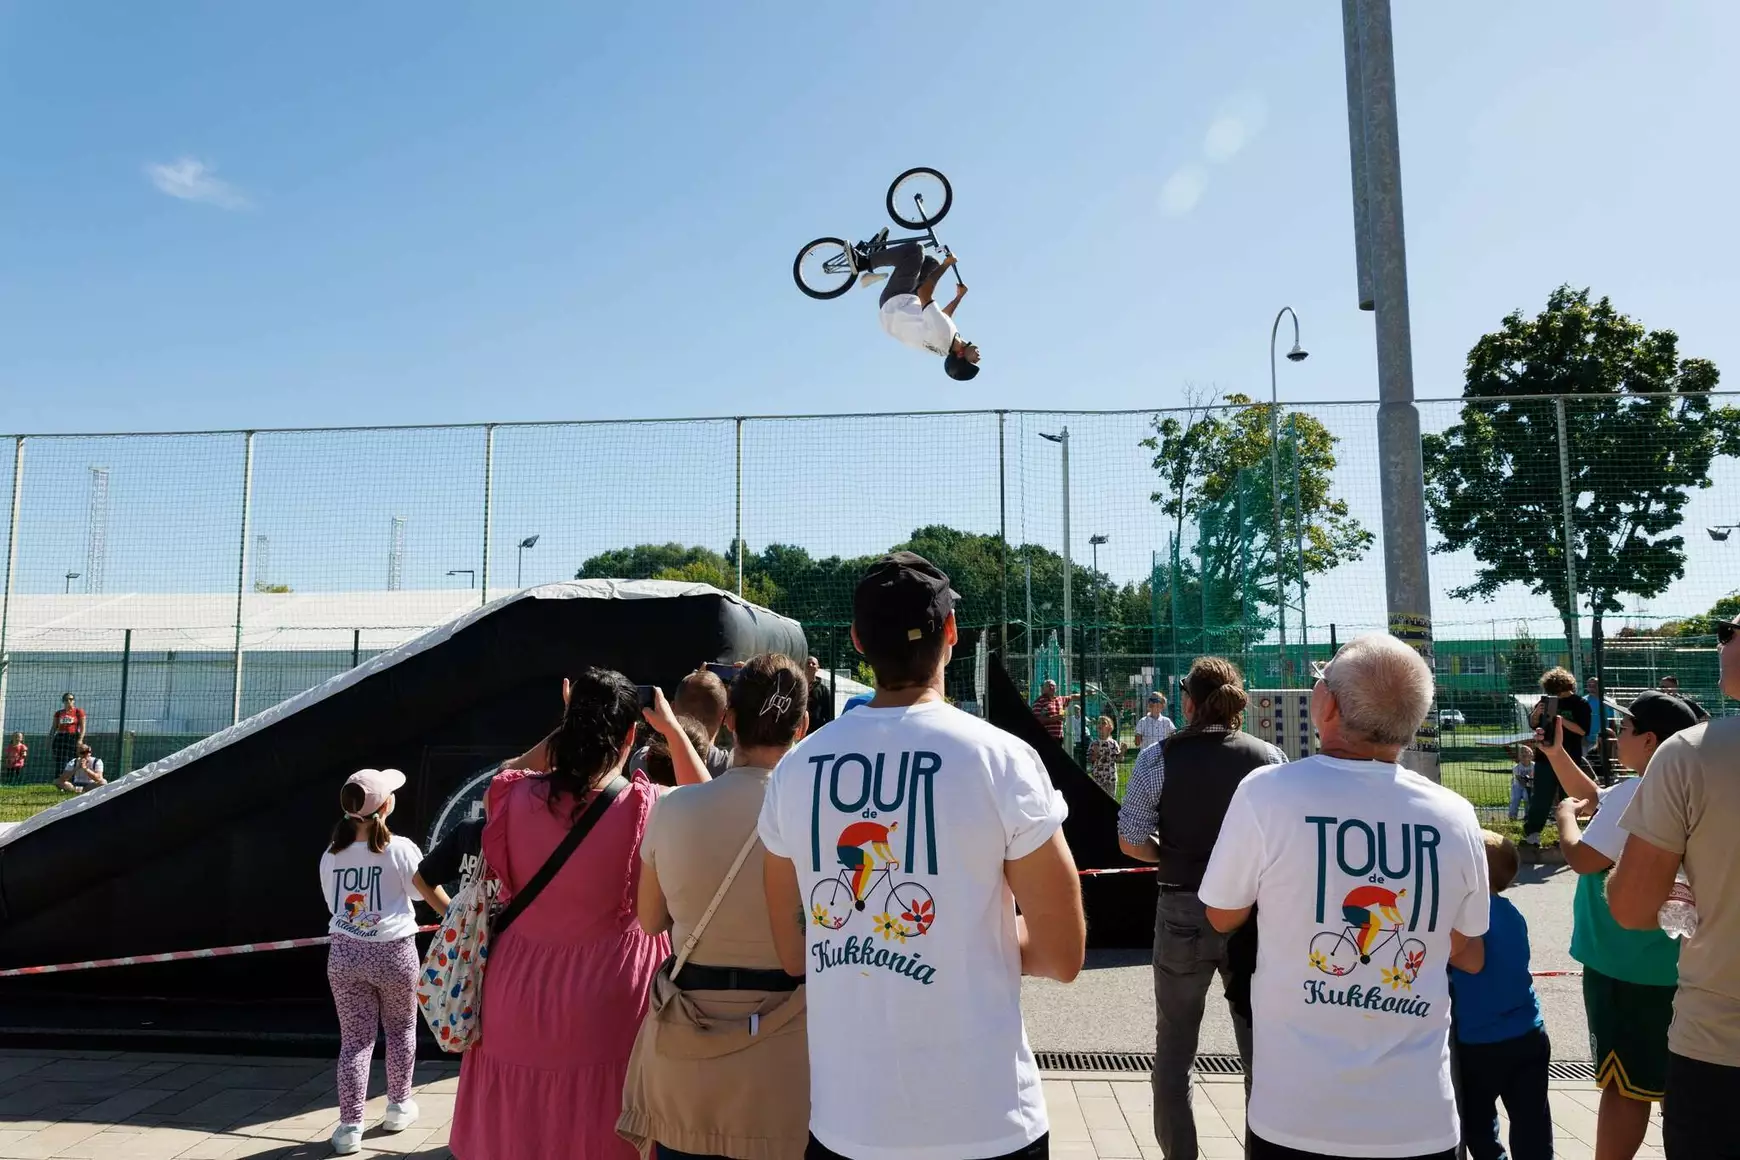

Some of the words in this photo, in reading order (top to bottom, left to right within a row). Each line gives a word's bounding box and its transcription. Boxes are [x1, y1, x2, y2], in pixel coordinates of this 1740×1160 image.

[808, 751, 942, 875] TOUR
[861, 808, 878, 819] de
[333, 866, 382, 914] TOUR
[1305, 816, 1441, 932] TOUR
[1368, 873, 1385, 884] de
[811, 935, 937, 985] Kukkonia
[1303, 979, 1431, 1018] Kukkonia
